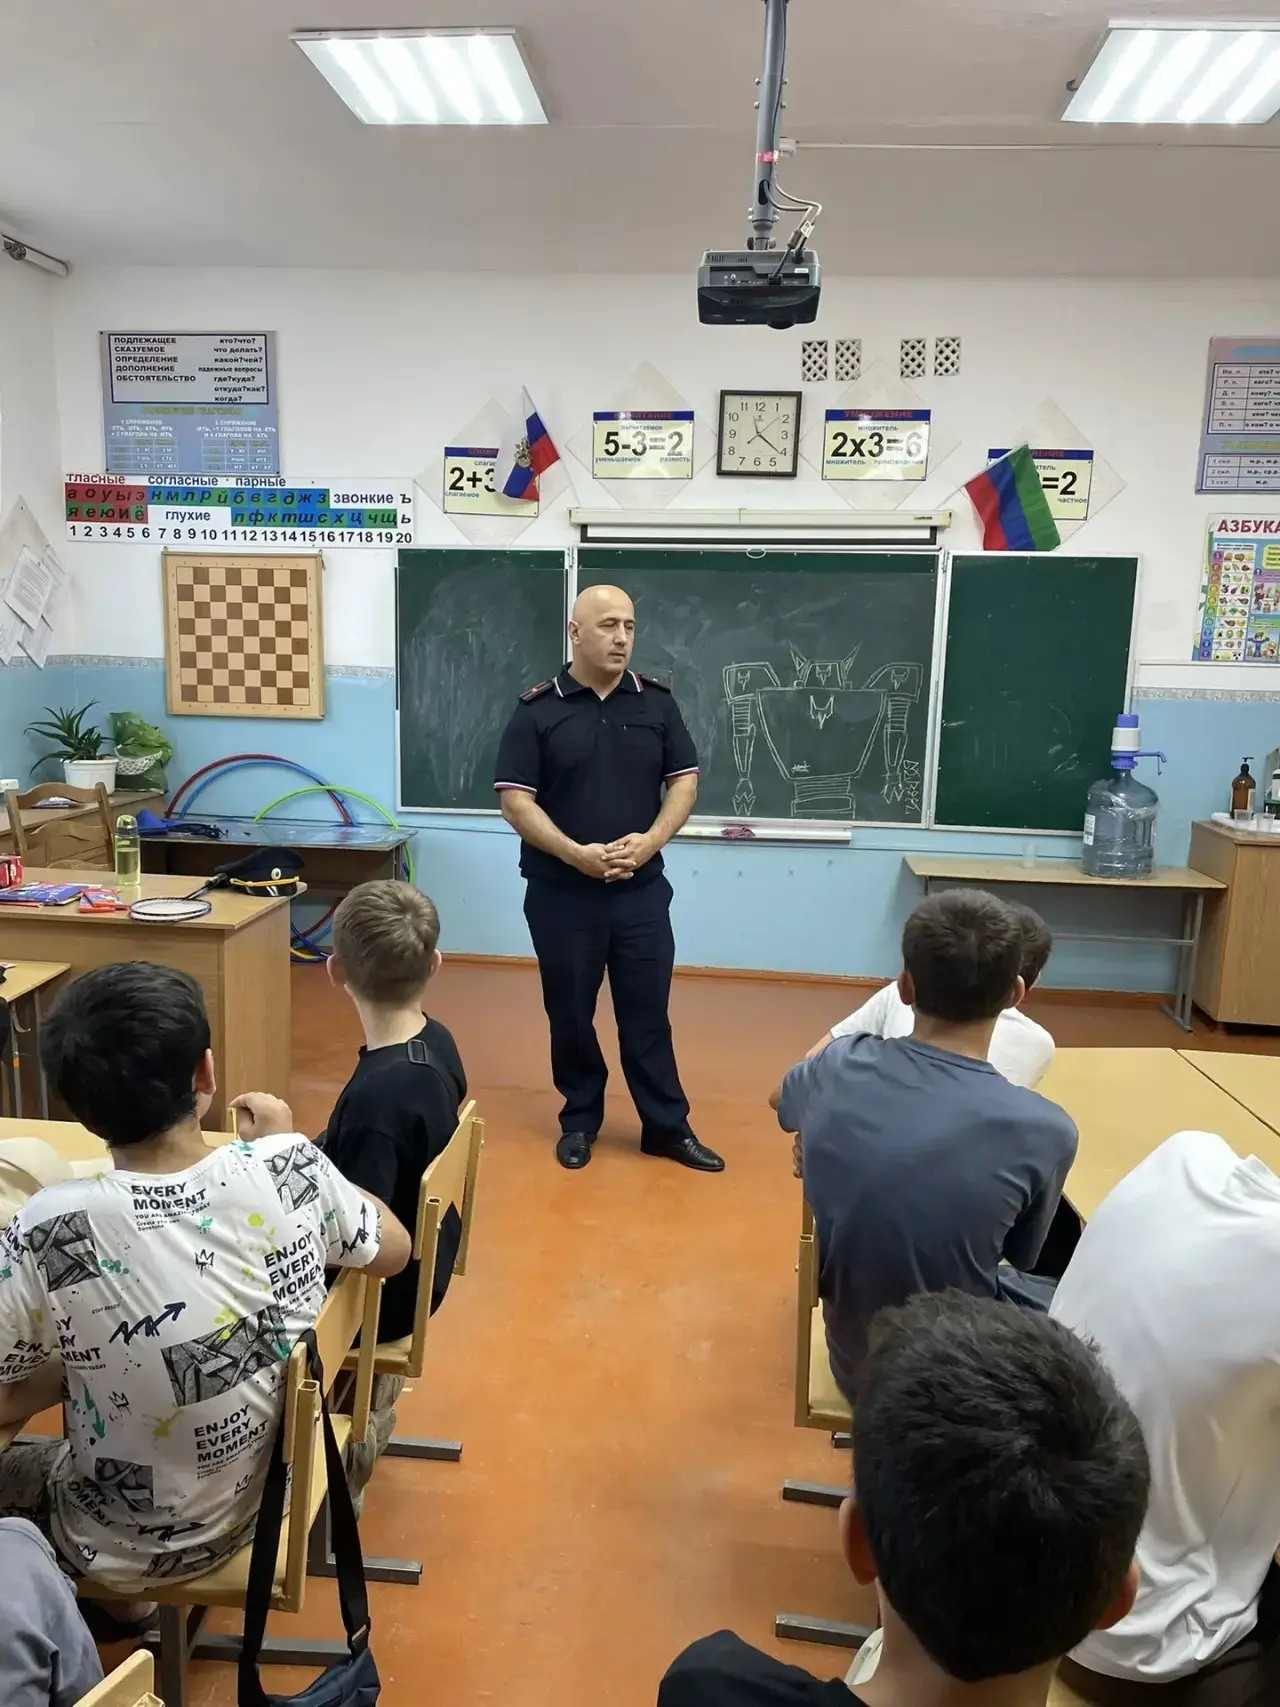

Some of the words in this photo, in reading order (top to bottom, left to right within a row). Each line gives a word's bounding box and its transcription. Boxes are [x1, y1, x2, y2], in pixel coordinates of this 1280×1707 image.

[740, 402, 748, 411] 11
[755, 402, 766, 412] 12
[776, 402, 779, 412] 1
[728, 412, 739, 422] 10
[782, 414, 790, 424] 2
[729, 429, 736, 438] 9
[781, 430, 788, 440] 3
[604, 431, 683, 456] 5-3=2
[728, 446, 735, 455] 8
[780, 448, 787, 456] 4
[739, 457, 746, 466] 7
[754, 457, 761, 466] 6
[769, 457, 777, 466] 5
[68, 474, 126, 484] гласные
[148, 476, 219, 486] согласные
[235, 477, 286, 488] парные
[68, 489, 77, 499] а
[85, 488, 96, 498] о
[102, 490, 112, 502] у
[116, 491, 130, 501] ы
[136, 491, 145, 500] э
[151, 490, 164, 500] н
[166, 491, 180, 501] м
[183, 491, 196, 501] л
[200, 491, 212, 503] р
[217, 489, 228, 504] й
[234, 491, 245, 504] б
[251, 493, 262, 503] в
[298, 493, 312, 504] ж
[317, 493, 327, 504] з
[334, 493, 394, 504] звонкие
[68, 507, 79, 517] я
[86, 507, 95, 517] е
[100, 508, 115, 518] ю
[136, 505, 144, 521] ё
[166, 511, 210, 523] глухие
[234, 514, 244, 522] п
[249, 510, 264, 526] ф
[268, 513, 277, 522] к
[298, 513, 314, 523] ш
[318, 513, 328, 523] с
[332, 513, 344, 523] х
[351, 512, 362, 525] ц
[368, 514, 378, 523] ч
[381, 514, 397, 526] щ
[1217, 520, 1280, 533] АЗБУКА
[70, 526, 76, 536] 1
[84, 526, 92, 536] 2
[100, 526, 107, 537] 3
[113, 527, 122, 537] 4
[127, 527, 135, 538] 5
[142, 527, 150, 538] 6
[158, 528, 166, 538] 7
[173, 528, 182, 539] 8
[188, 528, 196, 539] 9
[201, 530, 217, 540] 10
[222, 530, 236, 540] 11
[241, 530, 257, 541] 12
[262, 531, 278, 542] 13
[281, 531, 297, 542] 14
[300, 531, 316, 542] 15
[319, 532, 335, 542] 16
[338, 532, 355, 542] 17
[357, 532, 373, 542] 18
[377, 532, 393, 543] 19
[396, 532, 412, 543] 20
[131, 1182, 187, 1197] EVERY
[133, 1188, 206, 1210] MOMENT
[264, 1231, 312, 1268] ENJOY
[269, 1248, 315, 1286] EVERY
[194, 1404, 249, 1437] ENJOY
[196, 1417, 251, 1450] EVERY
[198, 1420, 268, 1462] MOMENT
